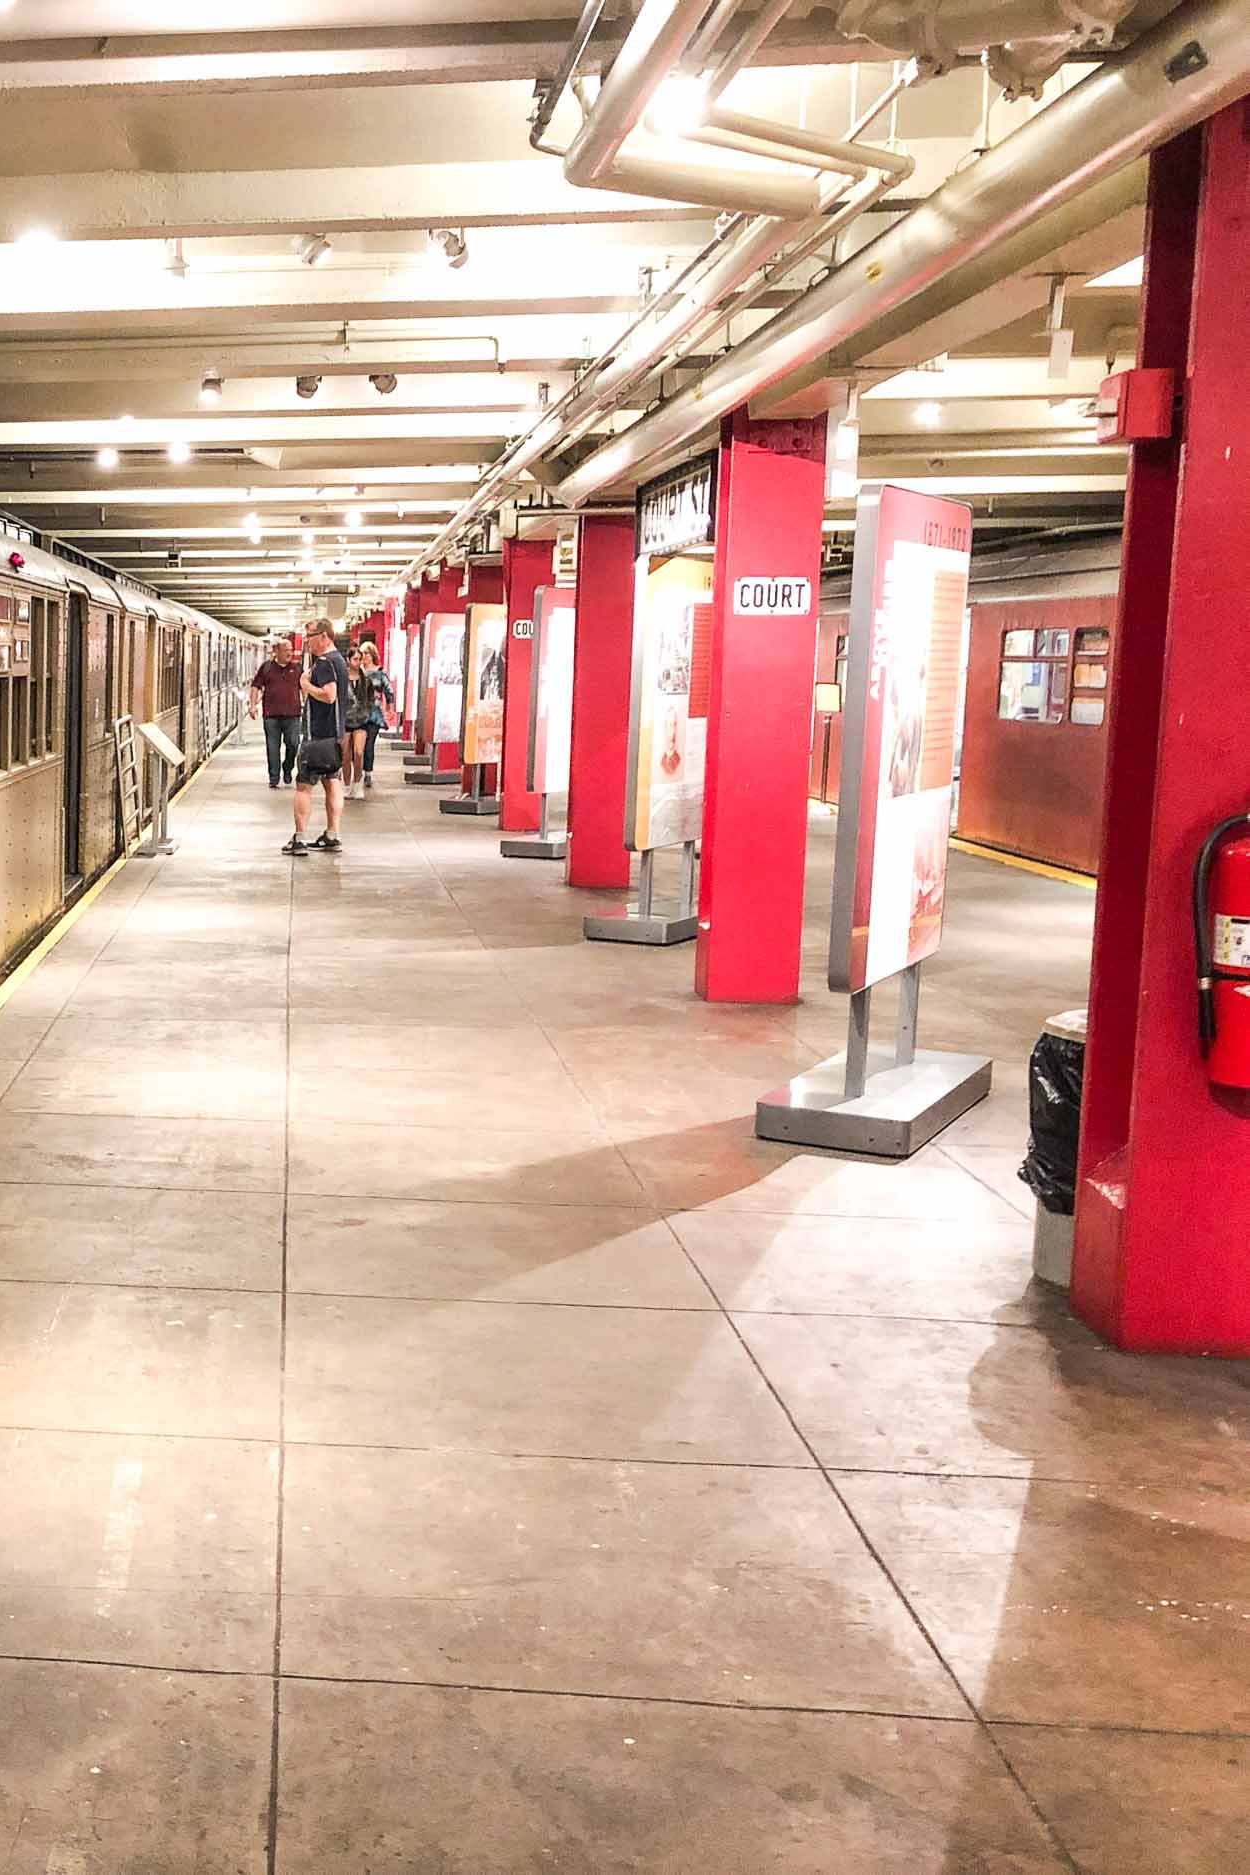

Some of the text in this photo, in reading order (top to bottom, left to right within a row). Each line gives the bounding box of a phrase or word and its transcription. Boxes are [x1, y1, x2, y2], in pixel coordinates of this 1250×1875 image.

[644, 472, 710, 545] COURT ST
[740, 583, 806, 608] COURT
[515, 622, 535, 636] COU
